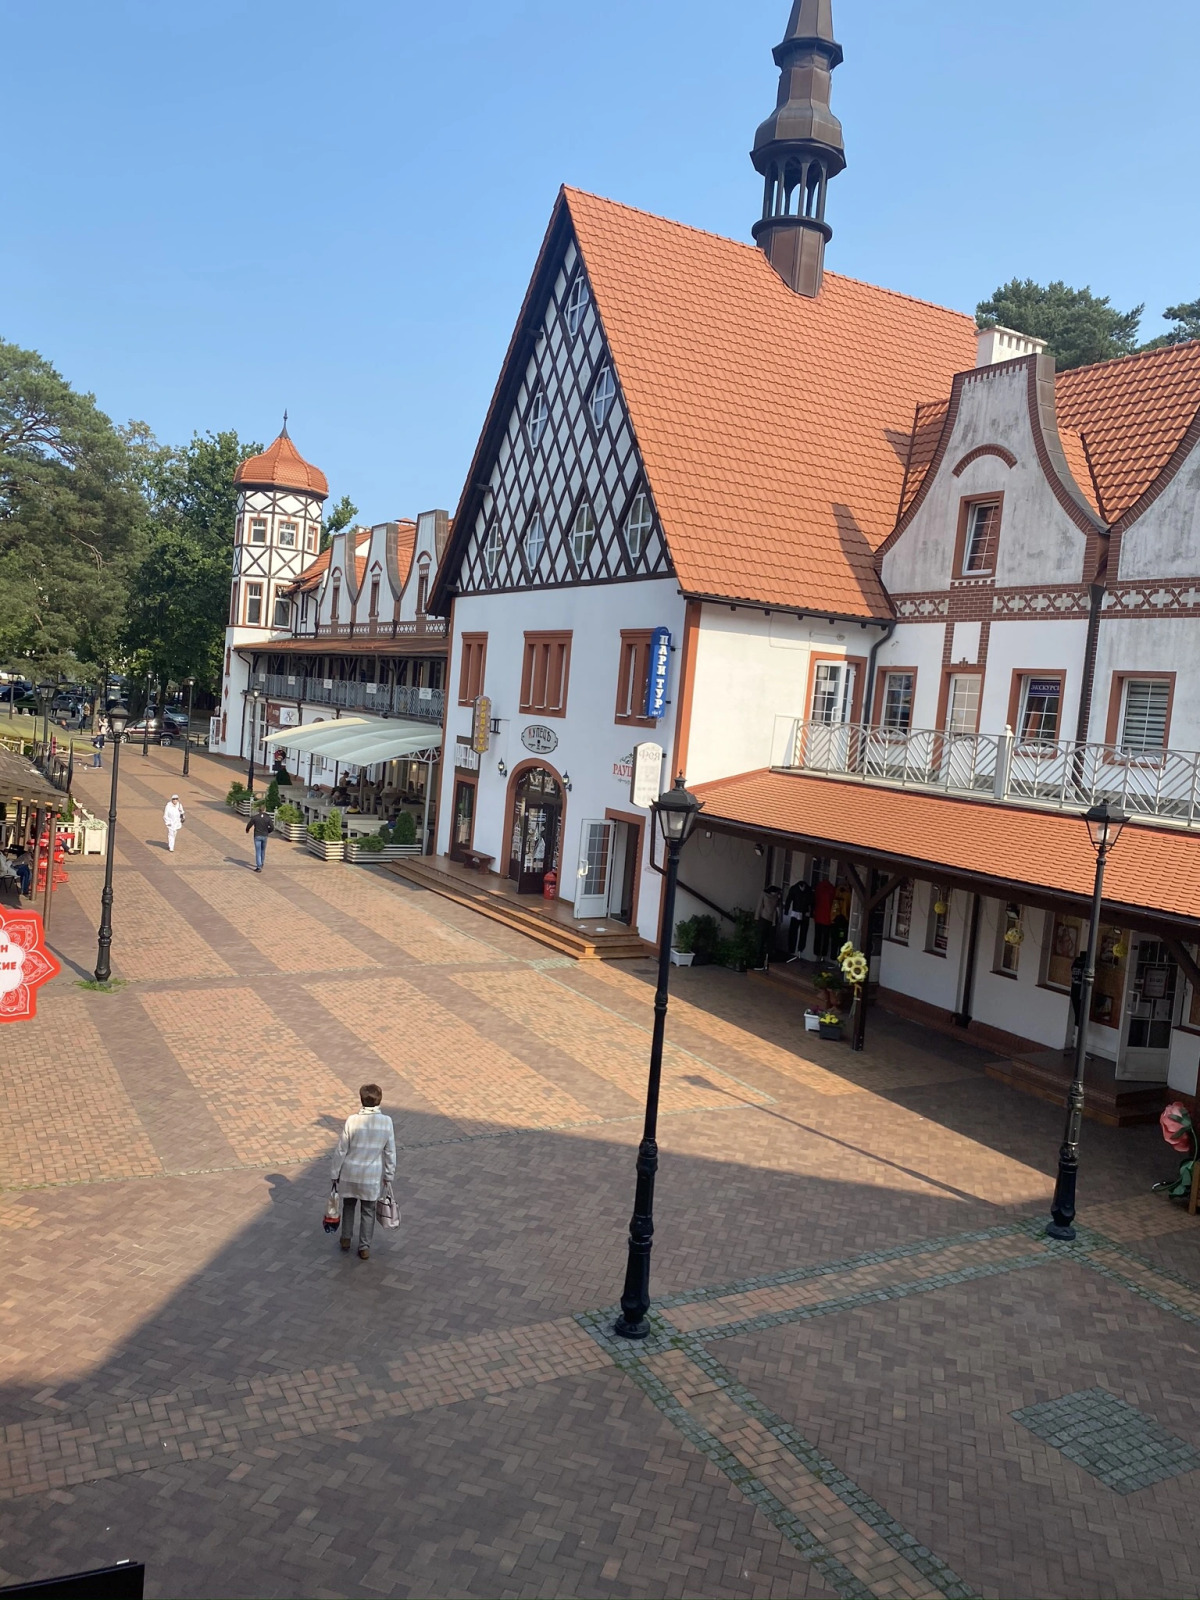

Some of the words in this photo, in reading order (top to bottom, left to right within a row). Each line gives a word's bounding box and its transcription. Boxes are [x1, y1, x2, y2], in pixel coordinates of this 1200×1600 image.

[656, 635, 669, 675] ПАРИ
[654, 679, 665, 709] ТУР
[477, 700, 487, 751] ПРОДУКТЫ
